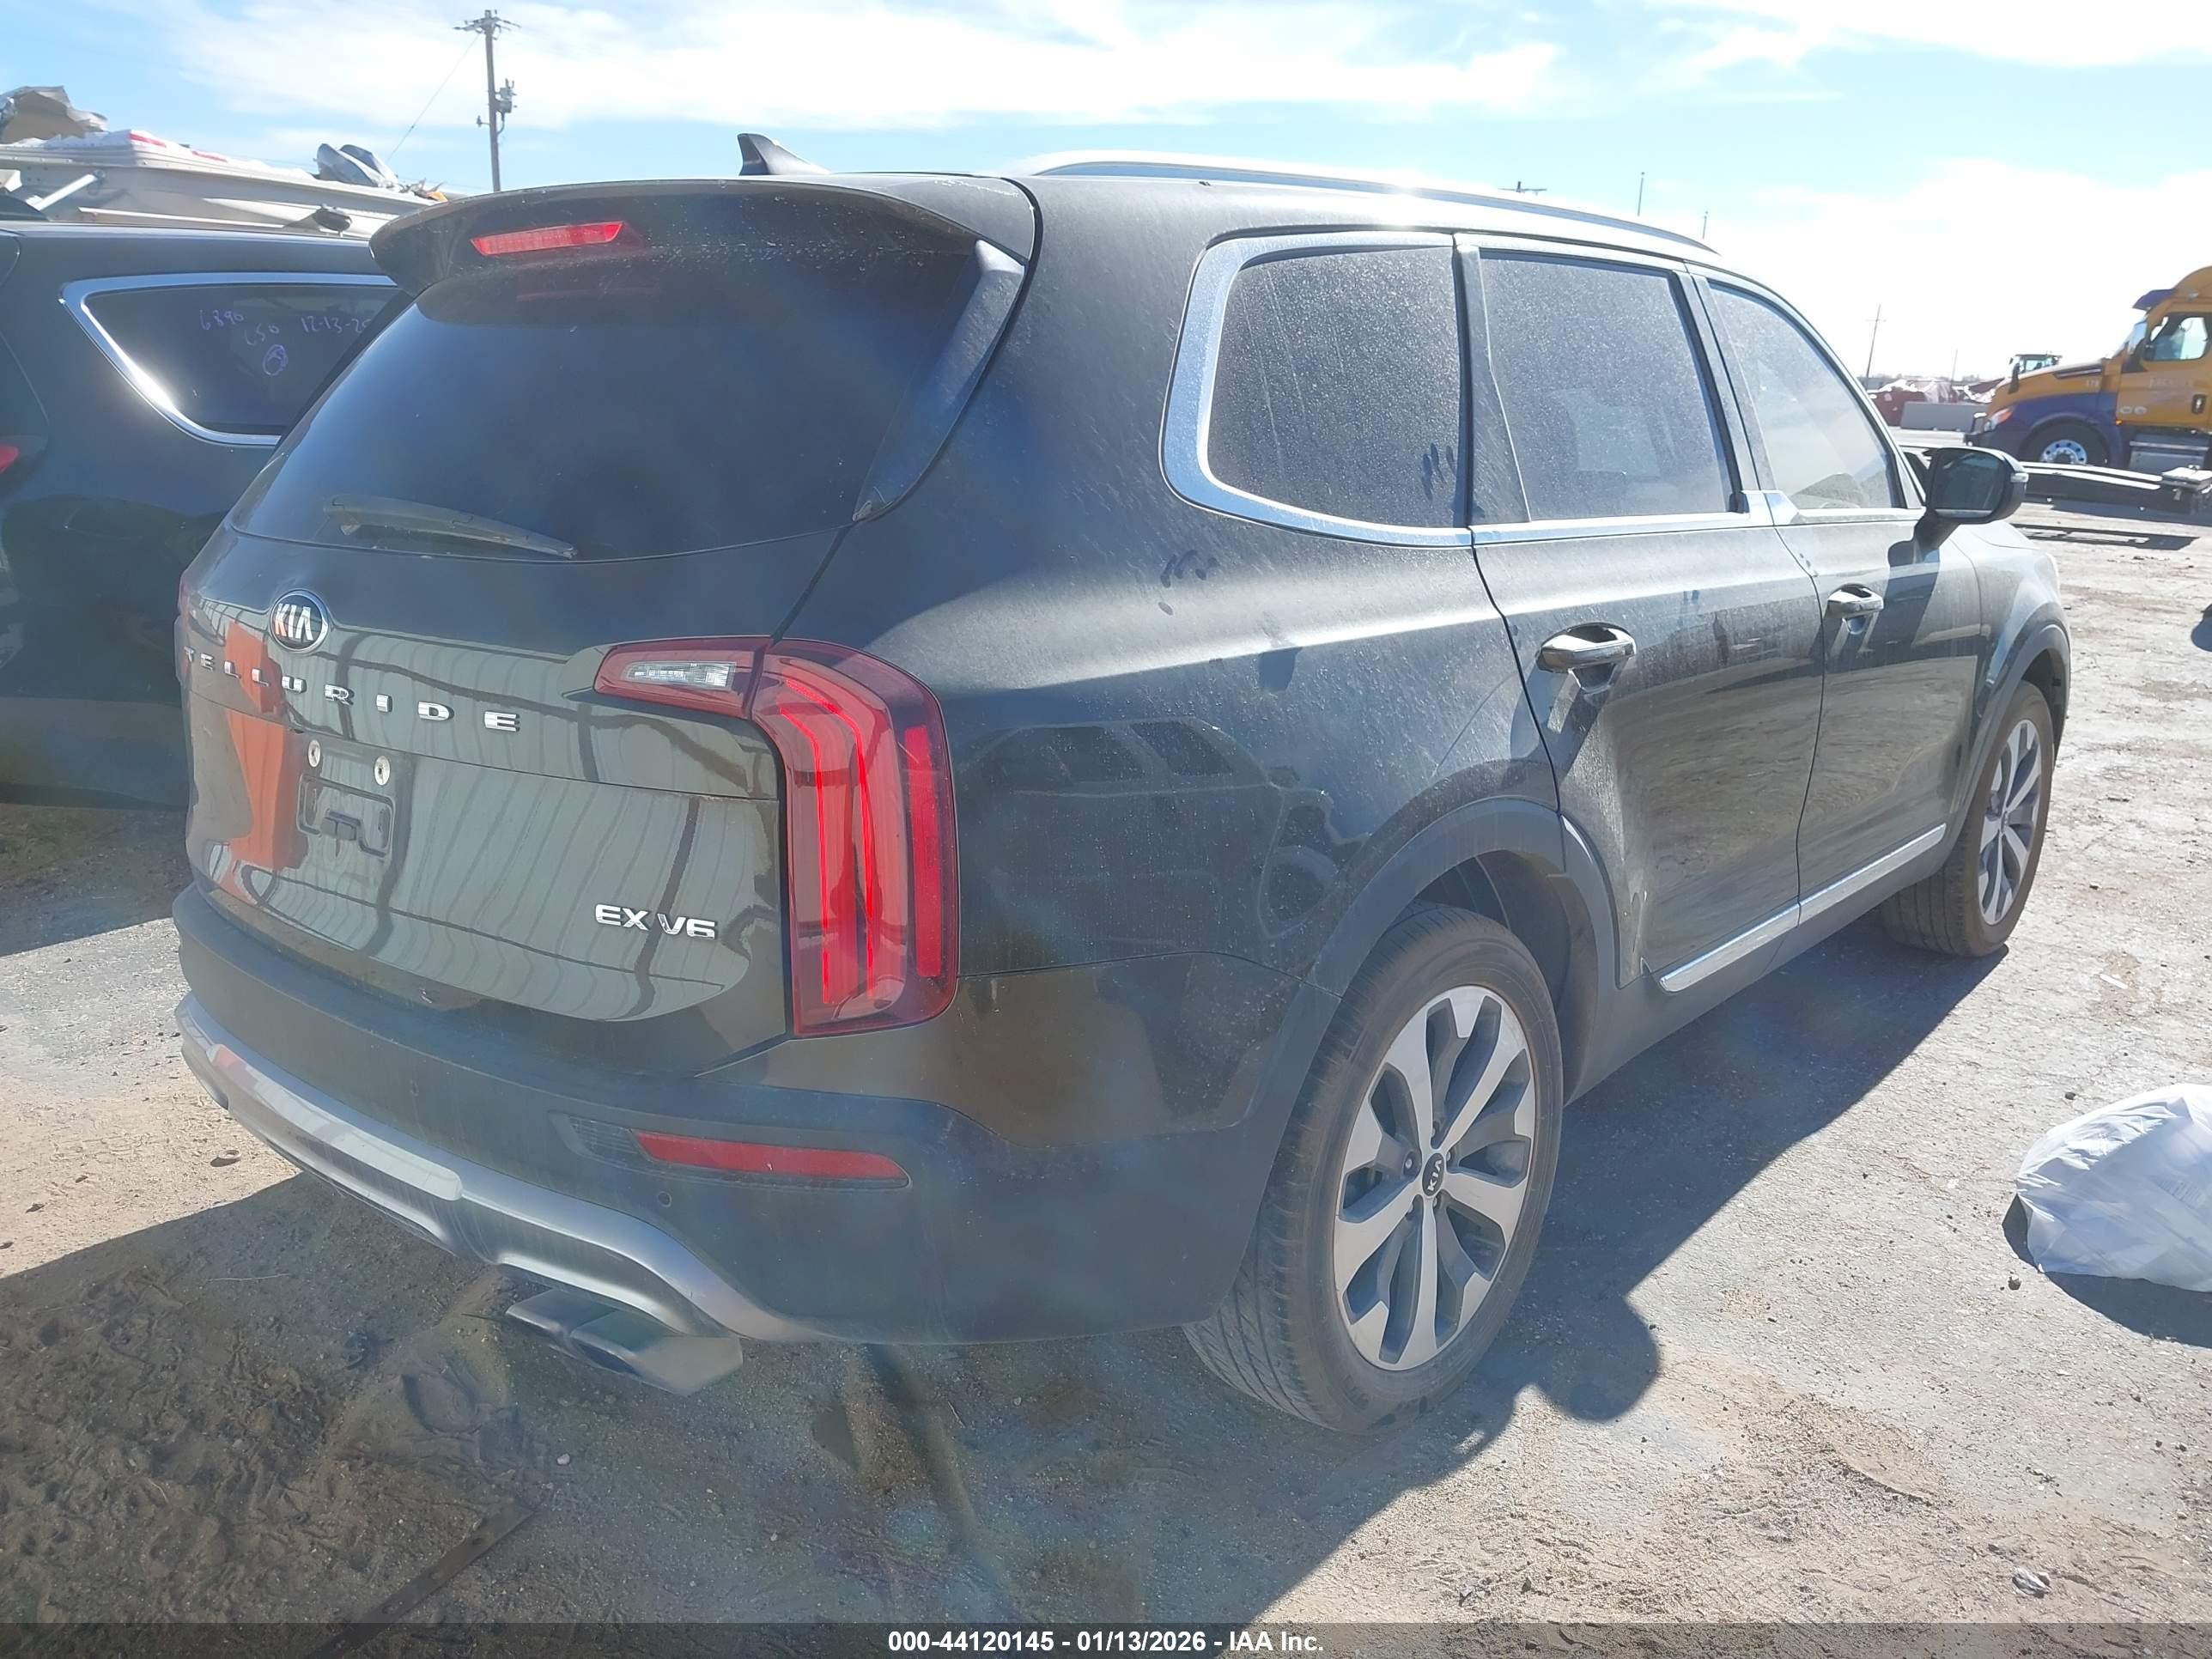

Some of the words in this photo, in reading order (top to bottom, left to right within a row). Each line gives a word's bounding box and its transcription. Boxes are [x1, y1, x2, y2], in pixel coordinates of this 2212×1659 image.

[199, 309, 245, 331] 6890
[274, 603, 313, 641] KIA
[183, 646, 521, 732] TELLURIDE
[595, 903, 649, 932] EX
[657, 913, 715, 940] V6
[1426, 1159, 1443, 1192] KIA
